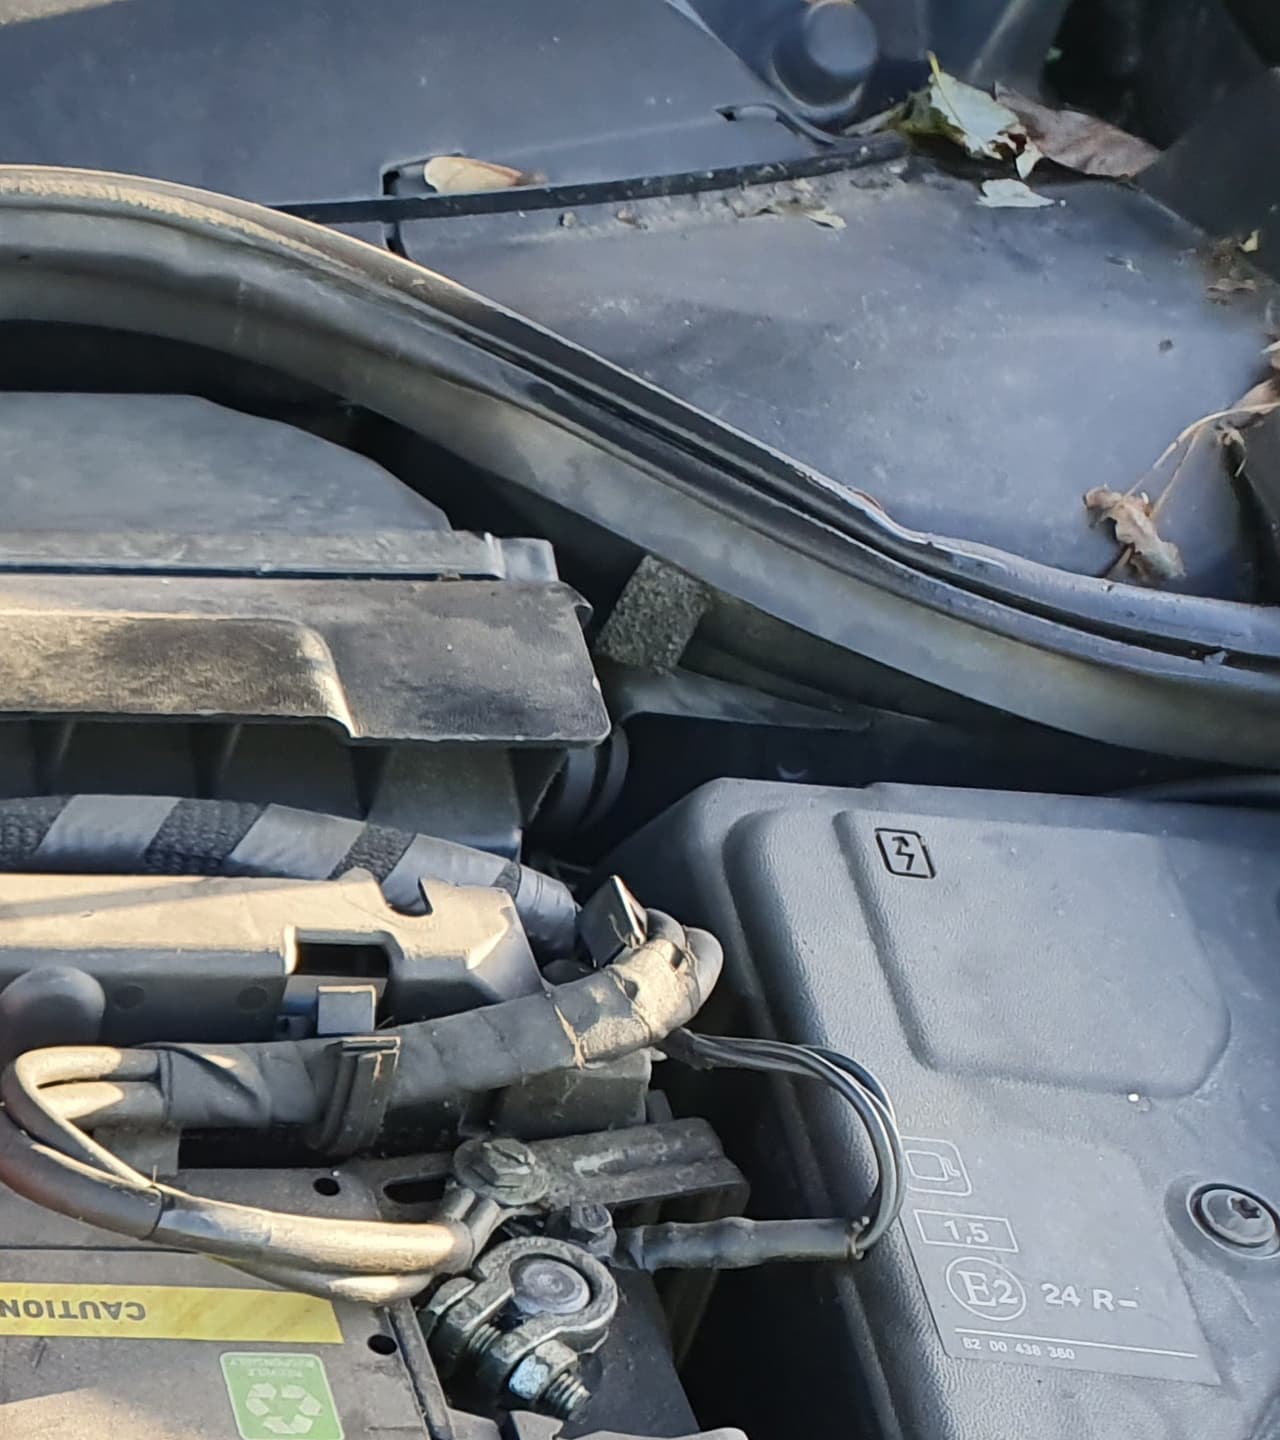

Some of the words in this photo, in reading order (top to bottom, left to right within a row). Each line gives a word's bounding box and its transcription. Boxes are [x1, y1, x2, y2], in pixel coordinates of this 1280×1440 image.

[943, 1219, 990, 1245] 1,5
[956, 1269, 1019, 1308] E2
[1040, 1282, 1081, 1308] 24
[989, 1340, 1008, 1353] 00
